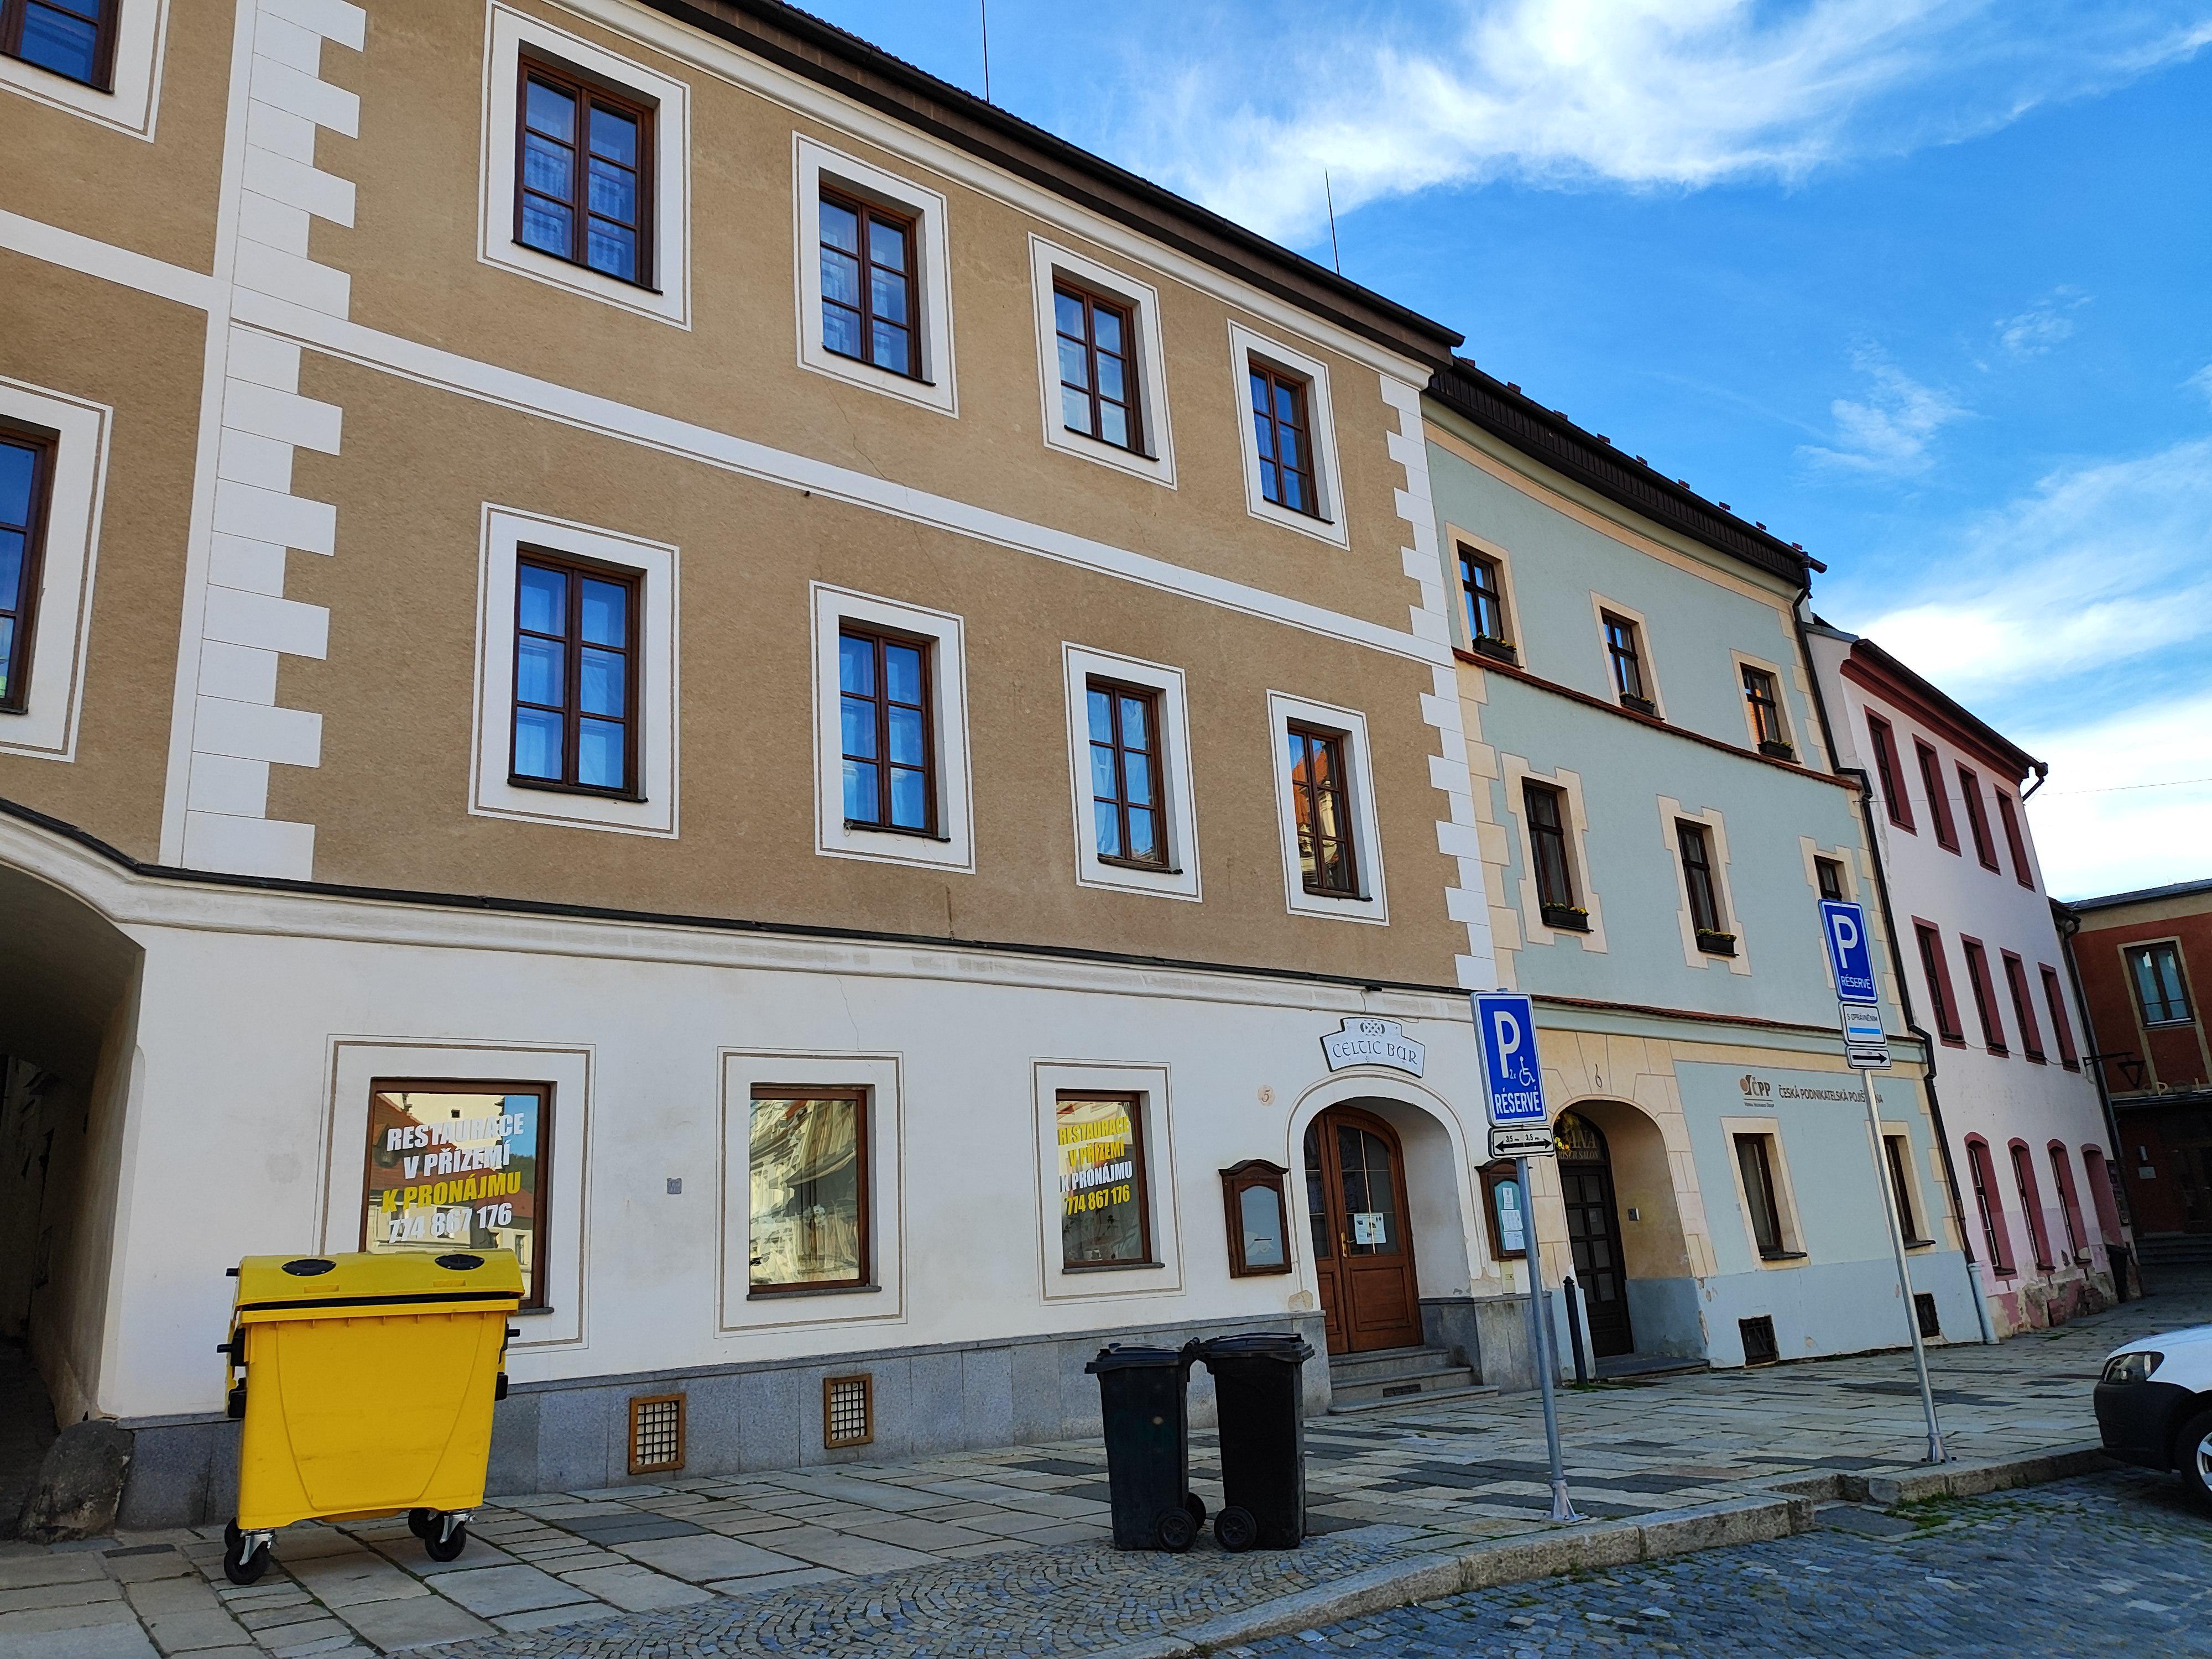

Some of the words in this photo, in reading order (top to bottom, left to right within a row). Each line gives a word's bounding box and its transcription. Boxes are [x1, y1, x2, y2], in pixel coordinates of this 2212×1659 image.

[1832, 914, 1858, 969] P
[1840, 974, 1872, 989] RÉSERVÉ
[1333, 1041, 1382, 1058] CELTIC
[1387, 1043, 1417, 1065] BAR
[1493, 1011, 1521, 1078] P
[1261, 1089, 1270, 1102] 5
[1495, 1086, 1541, 1114] RÉSERVÉ
[1751, 1077, 1771, 1097] ČPP
[1778, 1084, 1800, 1099] ČESKÁ
[387, 1113, 525, 1151] RESTAURACE
[1058, 1116, 1129, 1145] RESTAURACE
[403, 1156, 419, 1179] V
[423, 1140, 512, 1177] PŘÍZEMÍ
[1068, 1150, 1078, 1167] V
[1078, 1136, 1125, 1164] PŘÍZEMÍ
[1061, 1174, 1070, 1192] K
[1072, 1161, 1133, 1191] PRONÁJMU
[381, 1188, 398, 1213] K
[403, 1171, 521, 1211] PRONÁJMU
[1066, 1194, 1086, 1215] 774
[1088, 1188, 1109, 1211] 867
[1112, 1185, 1130, 1205] 176
[389, 1216, 425, 1244] 774
[430, 1208, 472, 1238] 867
[477, 1202, 513, 1229] 176
